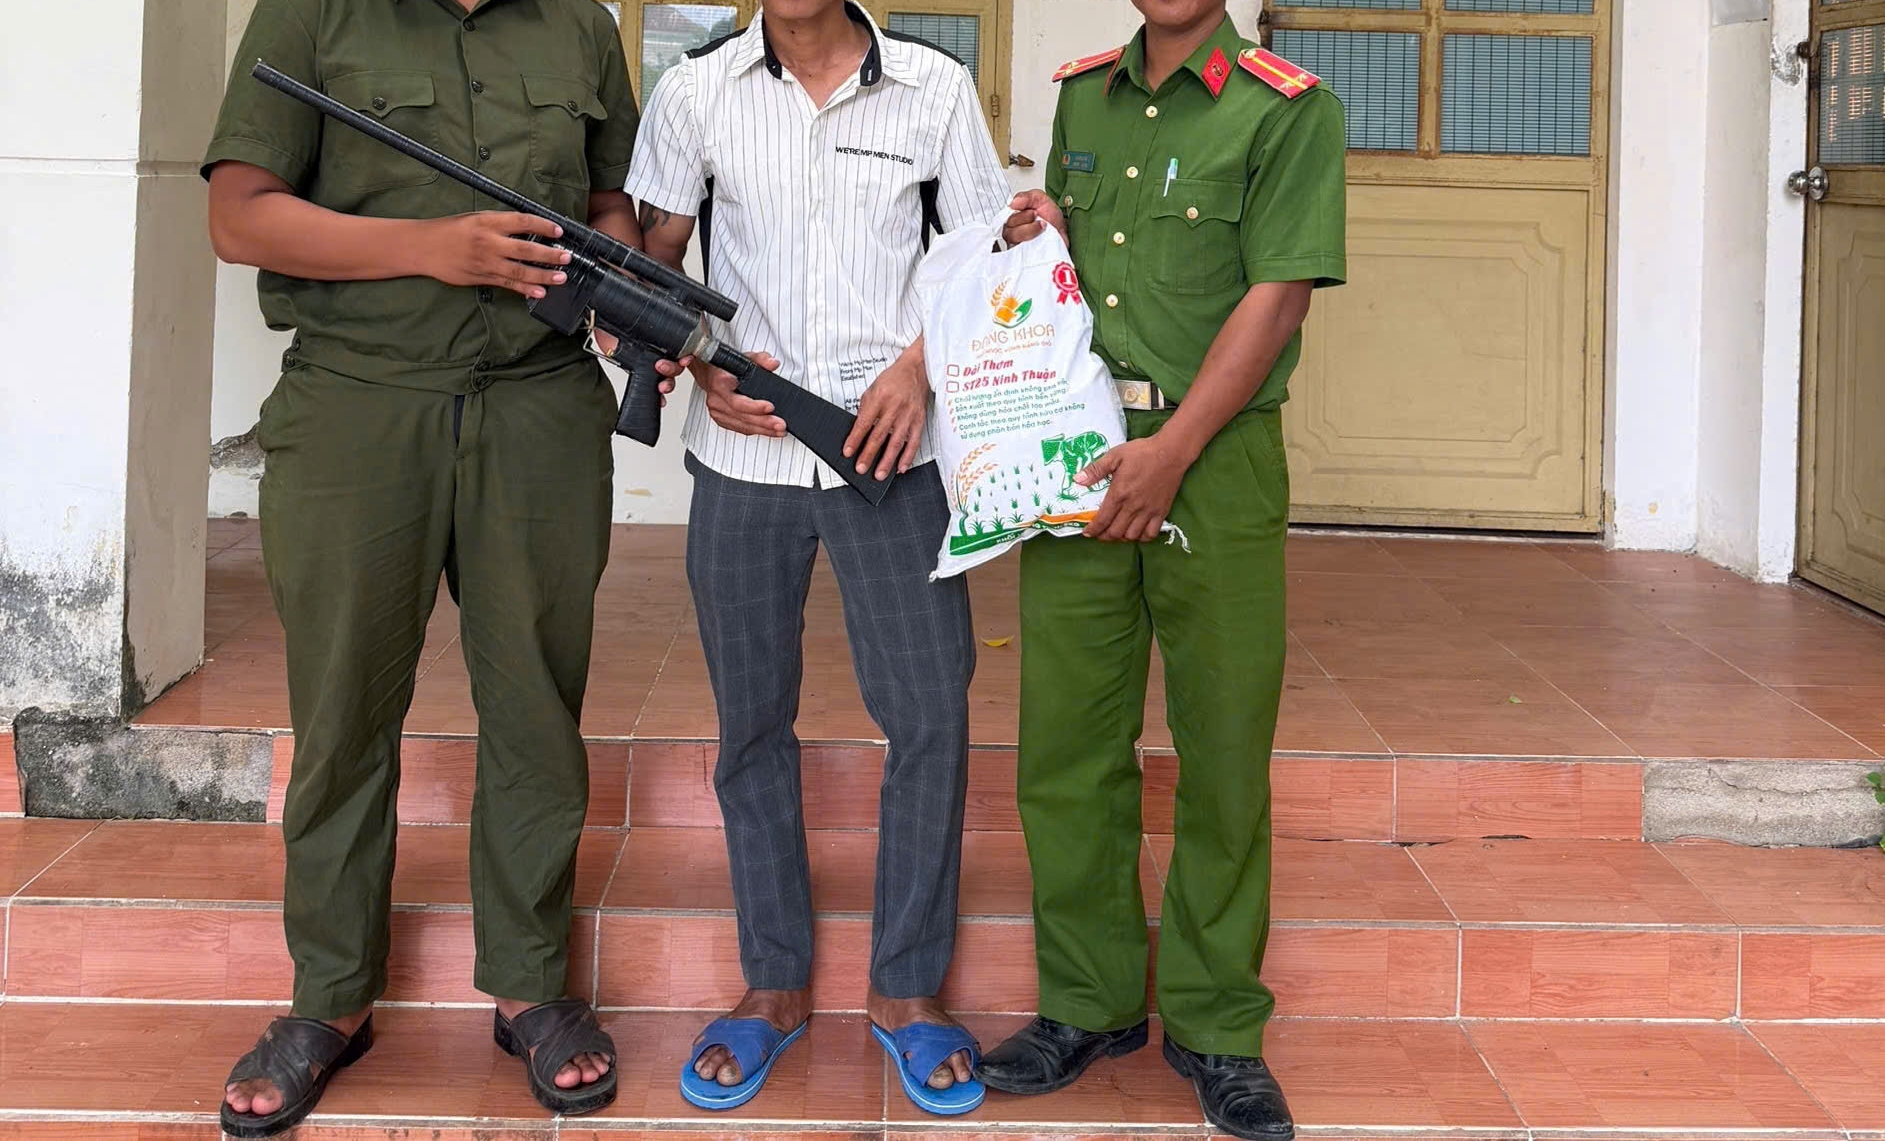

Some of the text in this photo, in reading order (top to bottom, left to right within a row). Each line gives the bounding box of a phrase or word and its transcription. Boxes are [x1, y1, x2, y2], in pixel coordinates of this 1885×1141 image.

[873, 151, 889, 160] MEN
[890, 154, 914, 166] STUDIO
[1013, 323, 1055, 342] KHOA
[983, 359, 1014, 371] Thơm
[962, 368, 1057, 392] ST25 Ninh Thuận
